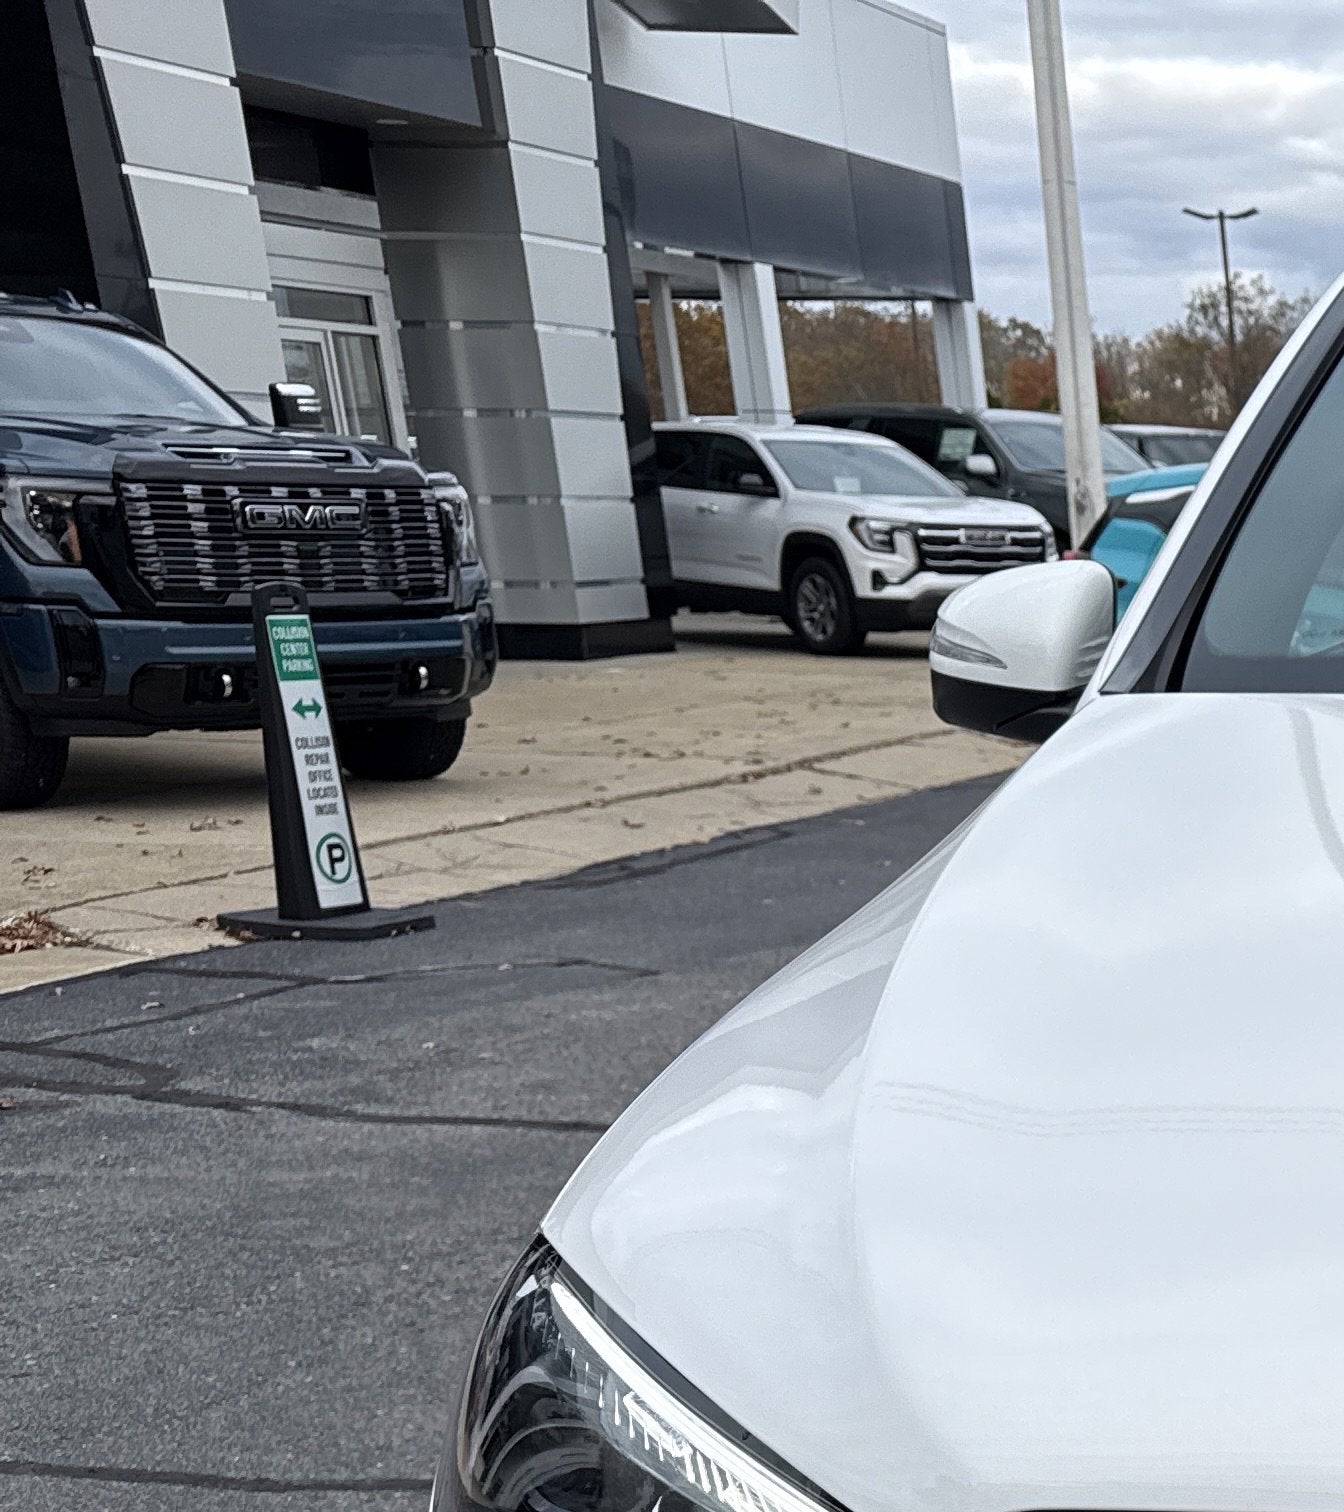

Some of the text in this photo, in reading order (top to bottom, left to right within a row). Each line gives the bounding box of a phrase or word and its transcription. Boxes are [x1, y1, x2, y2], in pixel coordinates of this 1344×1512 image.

[244, 504, 361, 530] GMC
[272, 626, 310, 641] COLLISION
[279, 642, 309, 657] CENTER
[282, 658, 314, 673] PARKING
[295, 736, 331, 750] COLLISION
[304, 752, 330, 766] REPAIR
[308, 769, 333, 783] OFFICE
